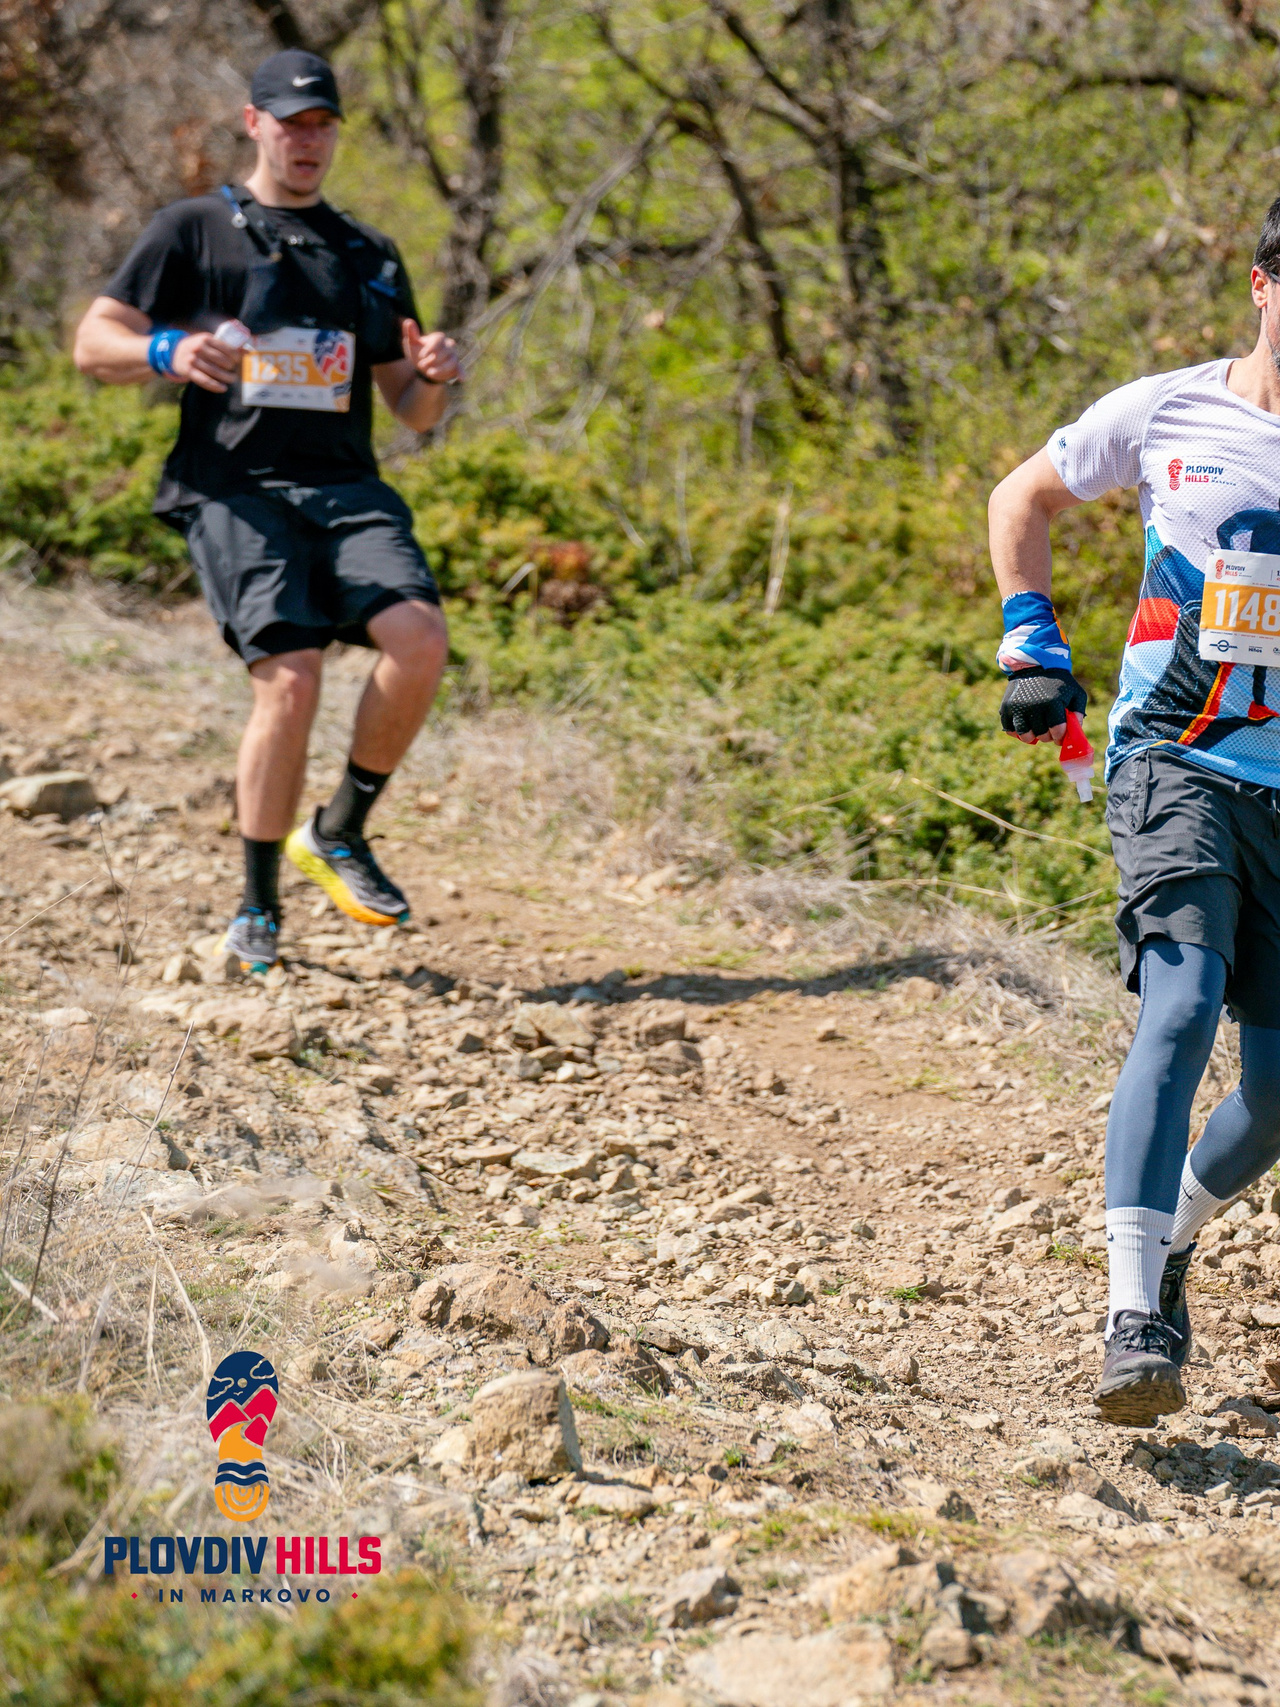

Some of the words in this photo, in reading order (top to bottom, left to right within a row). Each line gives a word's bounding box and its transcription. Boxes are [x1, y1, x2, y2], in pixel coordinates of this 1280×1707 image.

[250, 354, 309, 383] 1235
[1185, 465, 1224, 475] PLOVDIV
[1185, 474, 1209, 483] HILLS
